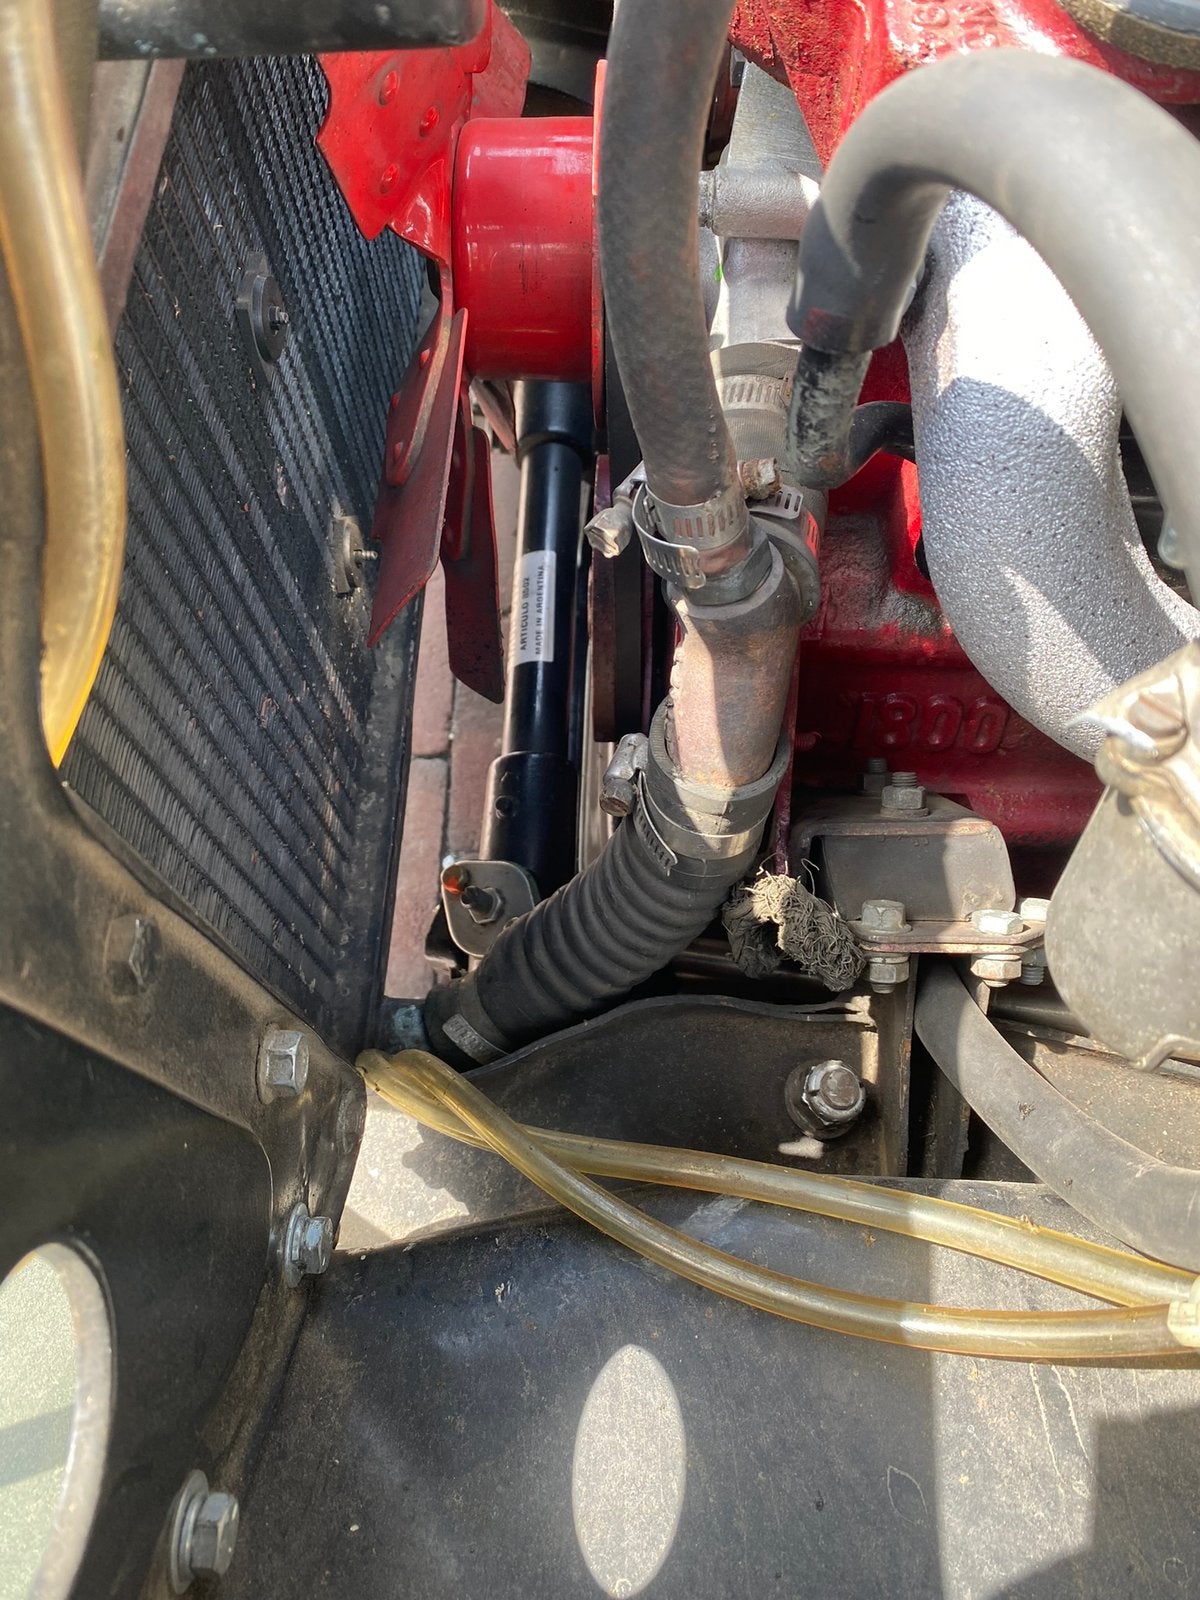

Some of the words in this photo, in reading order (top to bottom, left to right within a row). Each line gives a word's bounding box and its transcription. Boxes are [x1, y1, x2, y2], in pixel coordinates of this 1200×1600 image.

[536, 565, 545, 614] ARGENTINA
[520, 602, 529, 650] ARTICULO
[535, 631, 543, 655] MADE
[536, 617, 543, 627] IN
[854, 691, 1007, 754] 1800
